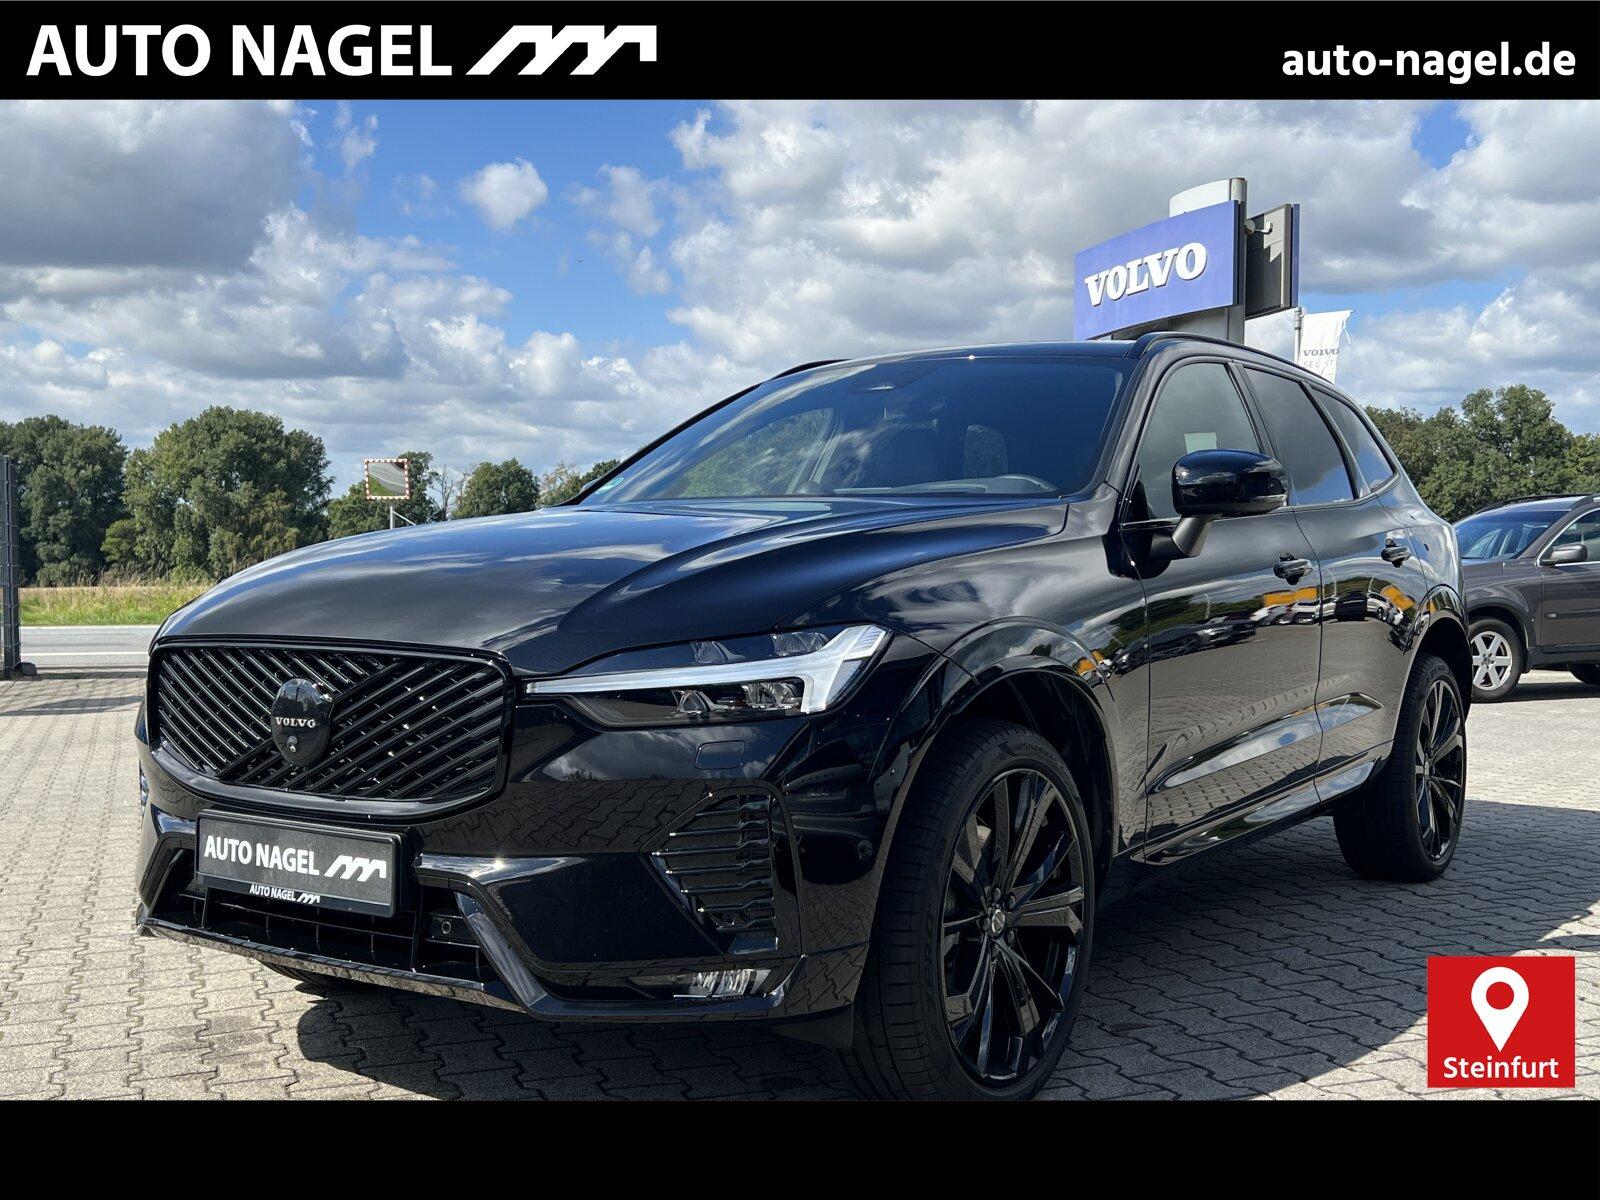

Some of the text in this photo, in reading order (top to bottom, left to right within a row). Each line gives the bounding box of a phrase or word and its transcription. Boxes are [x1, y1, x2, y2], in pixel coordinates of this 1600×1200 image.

[1085, 242, 1207, 306] VOLVO
[1303, 348, 1339, 356] VOLVO
[275, 717, 316, 728] VOLVO
[204, 835, 320, 876] AUTO NAGEL
[249, 884, 296, 902] AUTO NAGEL
